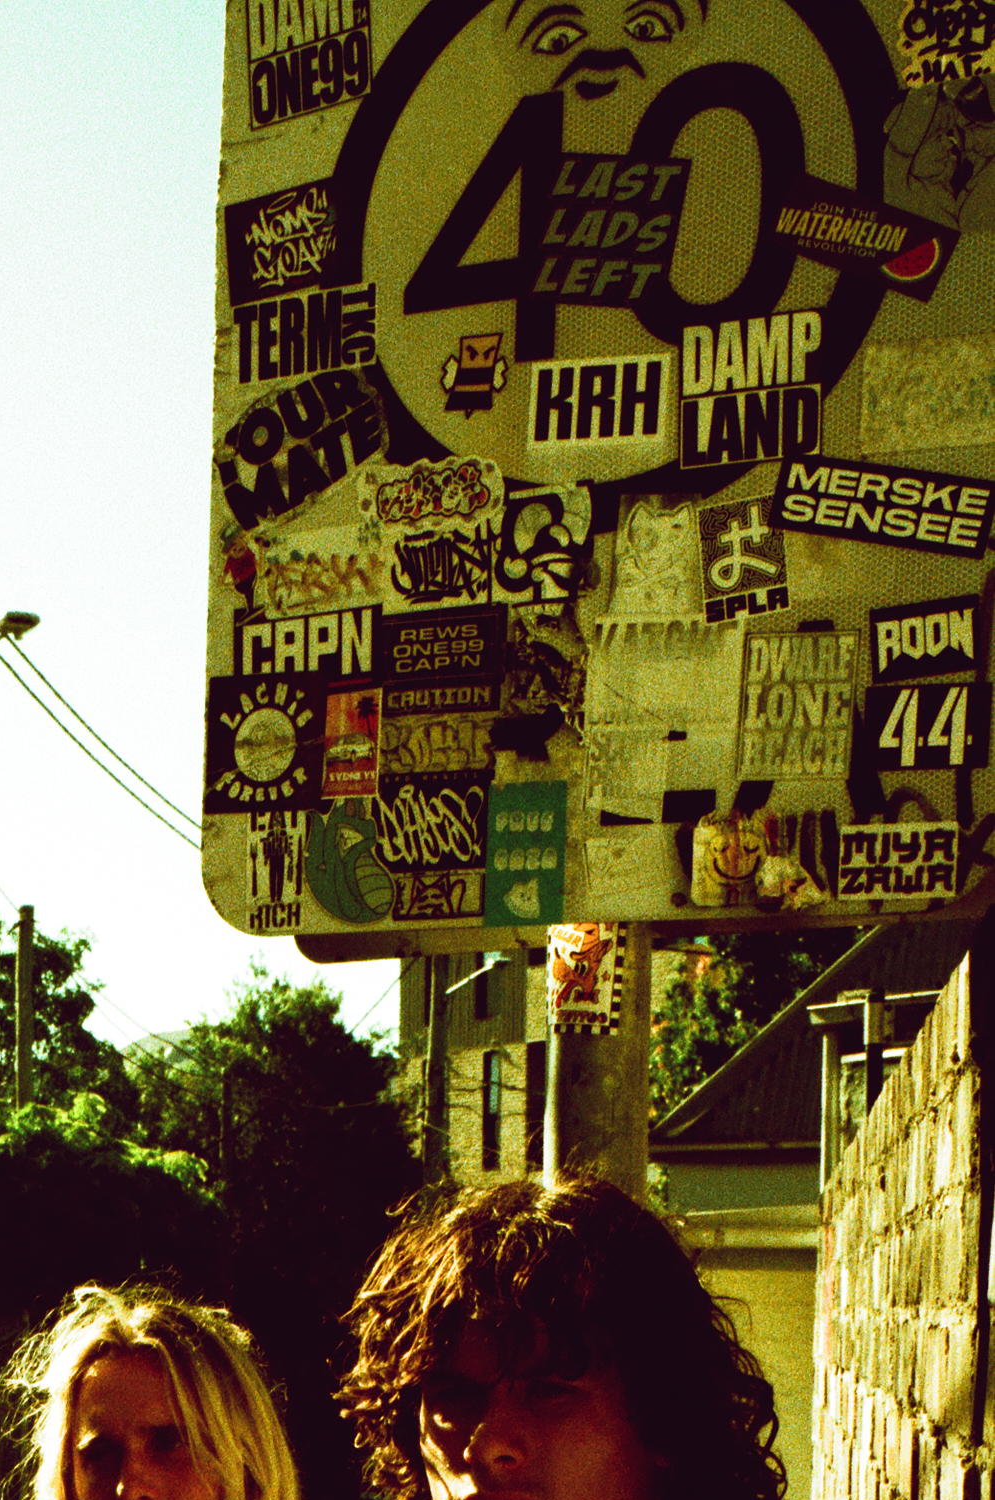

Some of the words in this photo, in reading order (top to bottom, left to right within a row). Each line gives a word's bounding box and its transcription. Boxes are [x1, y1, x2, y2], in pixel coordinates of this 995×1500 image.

[552, 160, 683, 202] LAST
[542, 208, 672, 252] LADS
[776, 207, 908, 253] WATERMELON
[810, 201, 845, 216] JOIN
[851, 206, 878, 221] THE
[797, 238, 877, 259] REVOLUTION
[532, 257, 663, 299] LEFT
[233, 290, 343, 384] TERM
[682, 311, 823, 396] DAMP
[534, 360, 662, 442] KRH
[682, 386, 820, 465] LAND
[224, 398, 381, 531] MATE
[786, 462, 991, 516] MERSKE
[781, 493, 983, 549] SENSEE
[706, 585, 789, 623] SPLA
[242, 608, 373, 677] CAPN
[392, 638, 485, 660] ONE99
[399, 624, 479, 643] REWS
[394, 653, 482, 674] CAP'N
[385, 685, 492, 710] CAUTION
[741, 728, 848, 779] BEACH
[214, 766, 309, 804] FOREVER
[840, 829, 957, 865] MIYA
[840, 863, 955, 894] ZAWA
[249, 902, 301, 930] RICH
